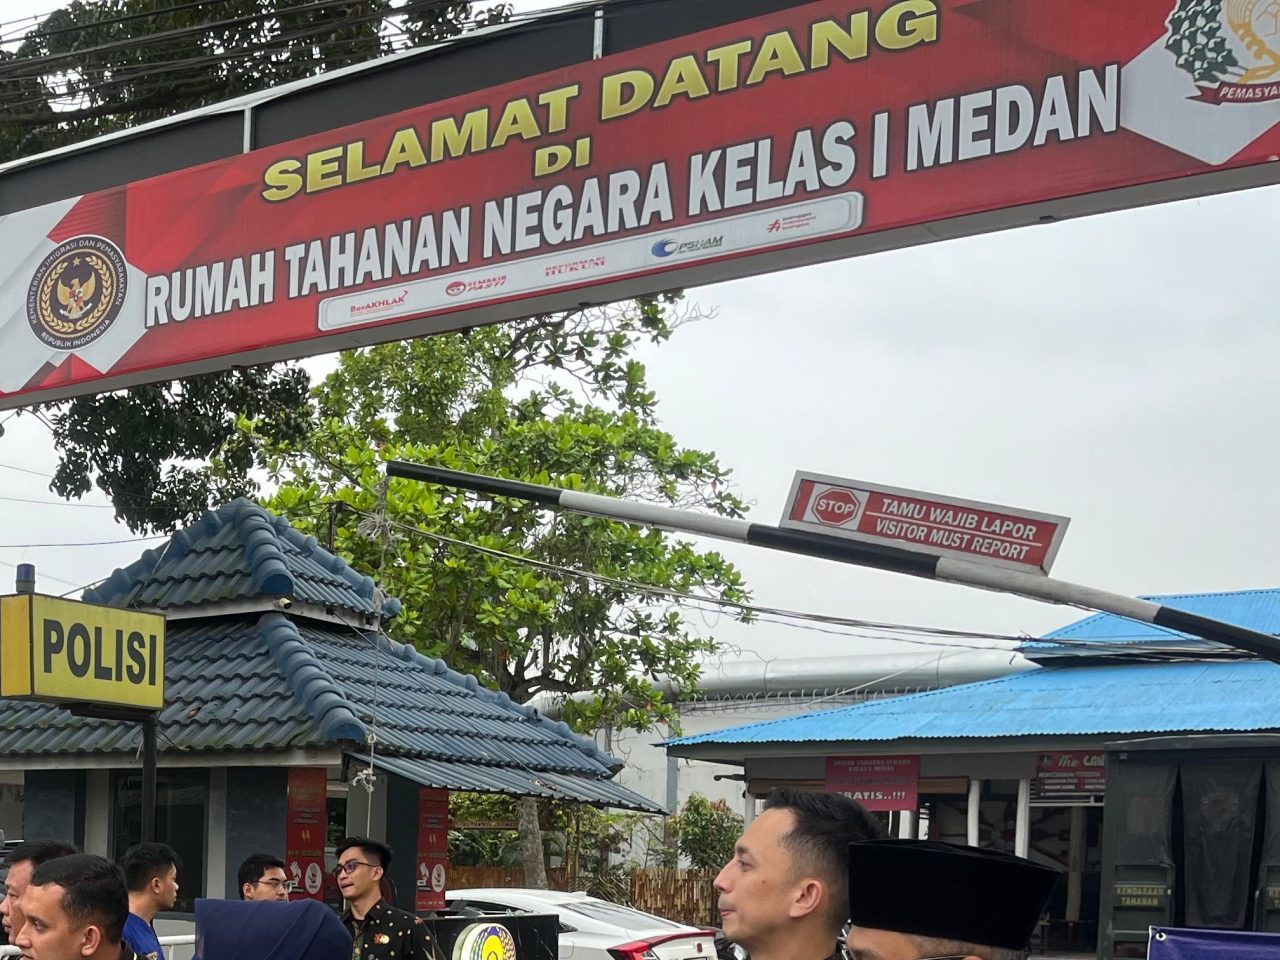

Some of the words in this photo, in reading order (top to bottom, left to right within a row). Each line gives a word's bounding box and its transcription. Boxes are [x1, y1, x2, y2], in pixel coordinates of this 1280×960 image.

[262, 84, 584, 202] SELAMAT
[601, 0, 938, 119] DATANG
[534, 137, 590, 177] DI
[146, 250, 274, 328] RUMAH
[285, 210, 469, 295] TAHANAN
[482, 164, 672, 258] NEGARA
[688, 121, 855, 215] KELAS
[871, 112, 888, 178] I
[906, 64, 1119, 170] MEDAN
[27, 266, 46, 325] KEMENTERIAN
[46, 242, 77, 266] IMIGRASI
[96, 242, 125, 305] PEMASYARAKATAN
[350, 295, 405, 313] BerAKHLAK
[41, 331, 71, 347] REPUBLIK
[73, 319, 111, 346] INDONESIA
[817, 498, 854, 516] STOP
[882, 498, 927, 518] TAMU
[929, 509, 978, 529] WAJIB
[981, 519, 1037, 541] LAPOR
[875, 518, 925, 538] VISITOR
[928, 529, 969, 549] MUST
[971, 538, 1029, 560] REPORT
[43, 618, 158, 686] POLISI
[837, 791, 906, 800] RATIS..!!!
